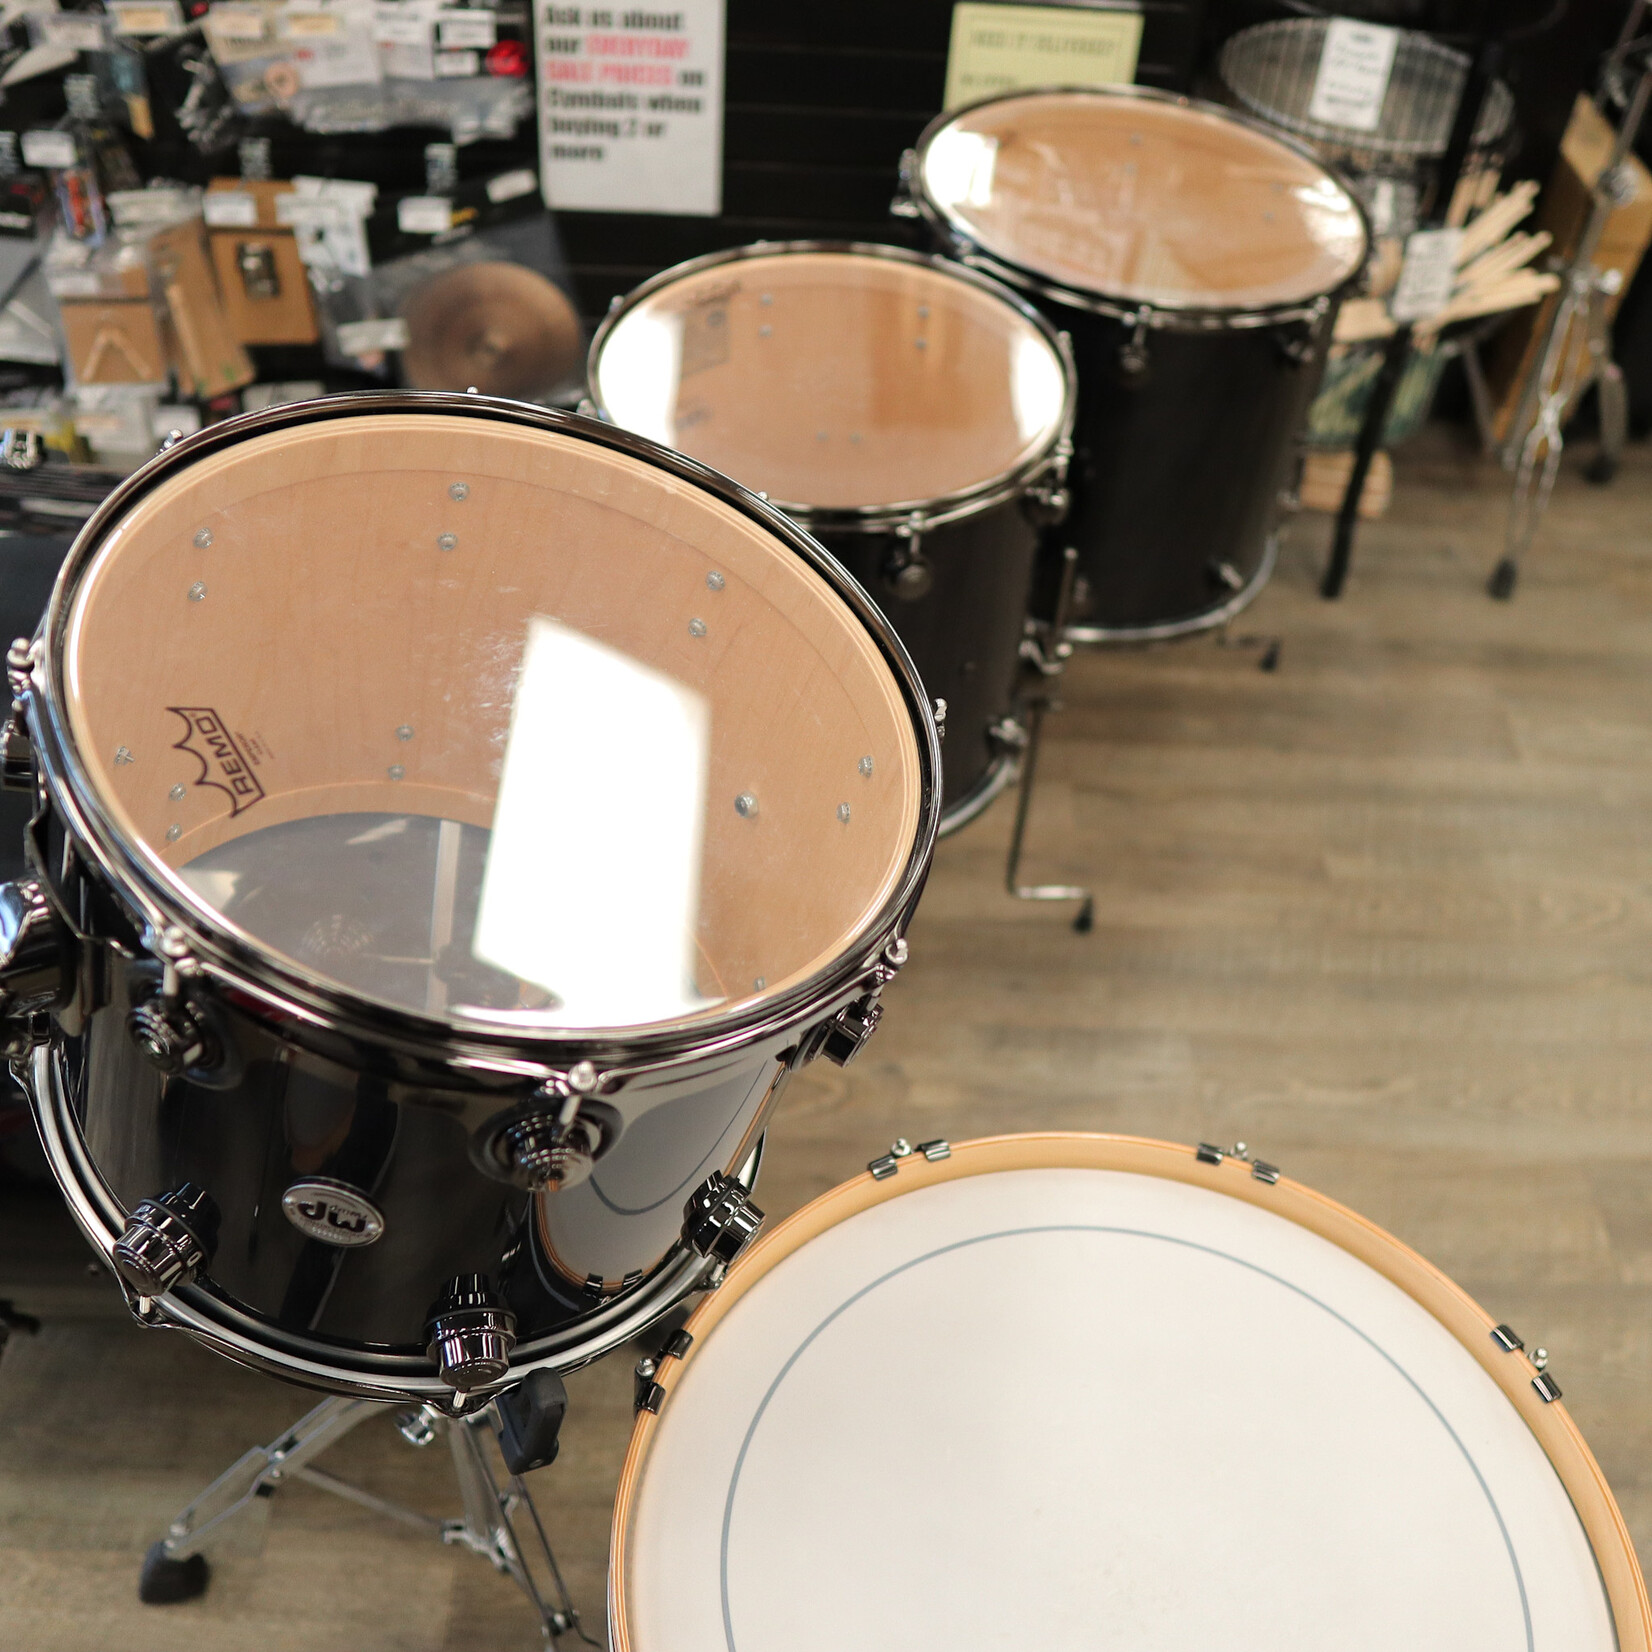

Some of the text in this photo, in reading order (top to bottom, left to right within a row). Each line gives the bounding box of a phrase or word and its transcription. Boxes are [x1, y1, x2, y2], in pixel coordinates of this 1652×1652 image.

[545, 60, 594, 83] SALE
[551, 143, 604, 161] more
[195, 716, 254, 795] REMO
